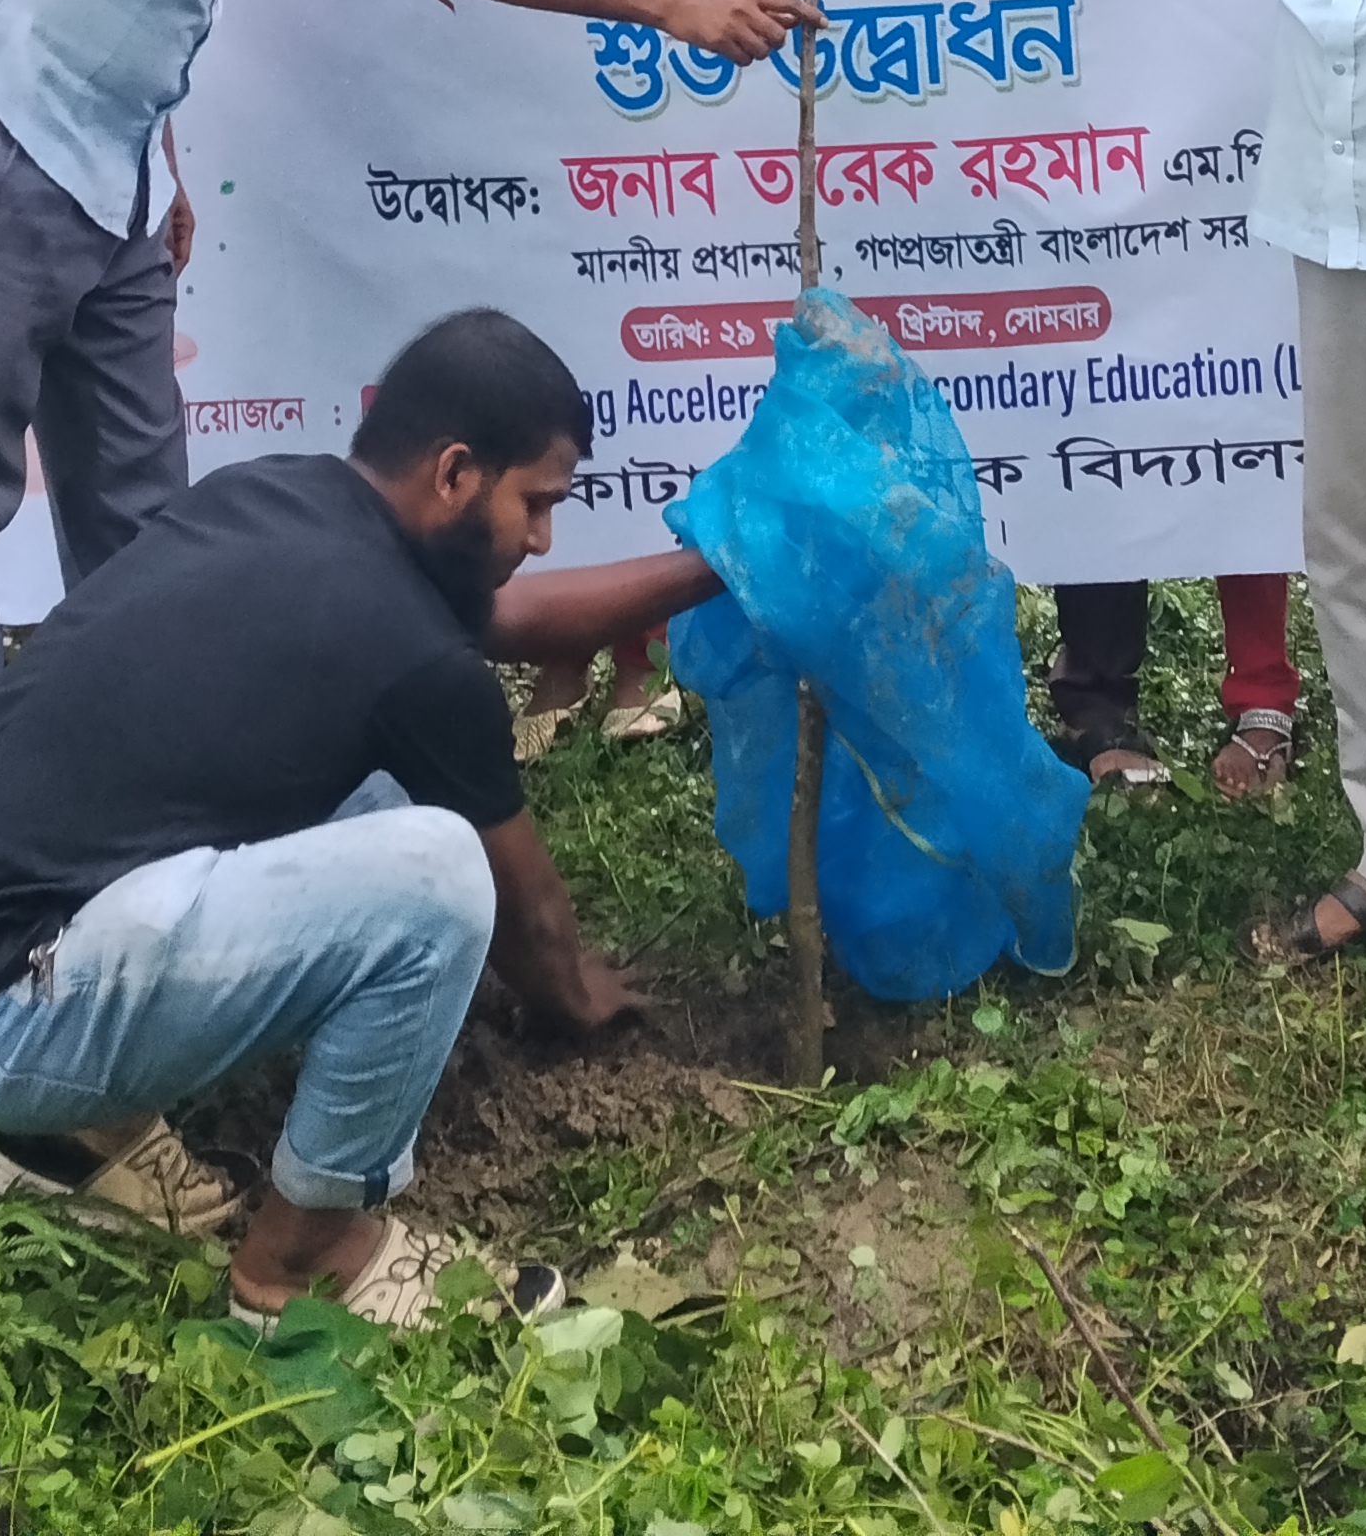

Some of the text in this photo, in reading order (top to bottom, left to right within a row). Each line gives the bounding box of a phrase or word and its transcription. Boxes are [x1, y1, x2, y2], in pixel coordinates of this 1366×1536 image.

[365, 163, 541, 226] উদ্বোধক:
[559, 147, 721, 219] জনাব
[734, 141, 937, 206] তরেক
[952, 122, 1150, 203] রহমান
[571, 235, 683, 284] মাননীয়
[855, 217, 1028, 273] গণপ্রজাতন্ত্রী
[1040, 215, 1192, 265] বাংলাদেশ
[630, 313, 711, 352] তারিখ:
[720, 319, 756, 351] ২৯
[1005, 301, 1100, 336] সোমবার
[1087, 347, 1264, 405] Education
[1047, 436, 1305, 491] বিদ্যাল
